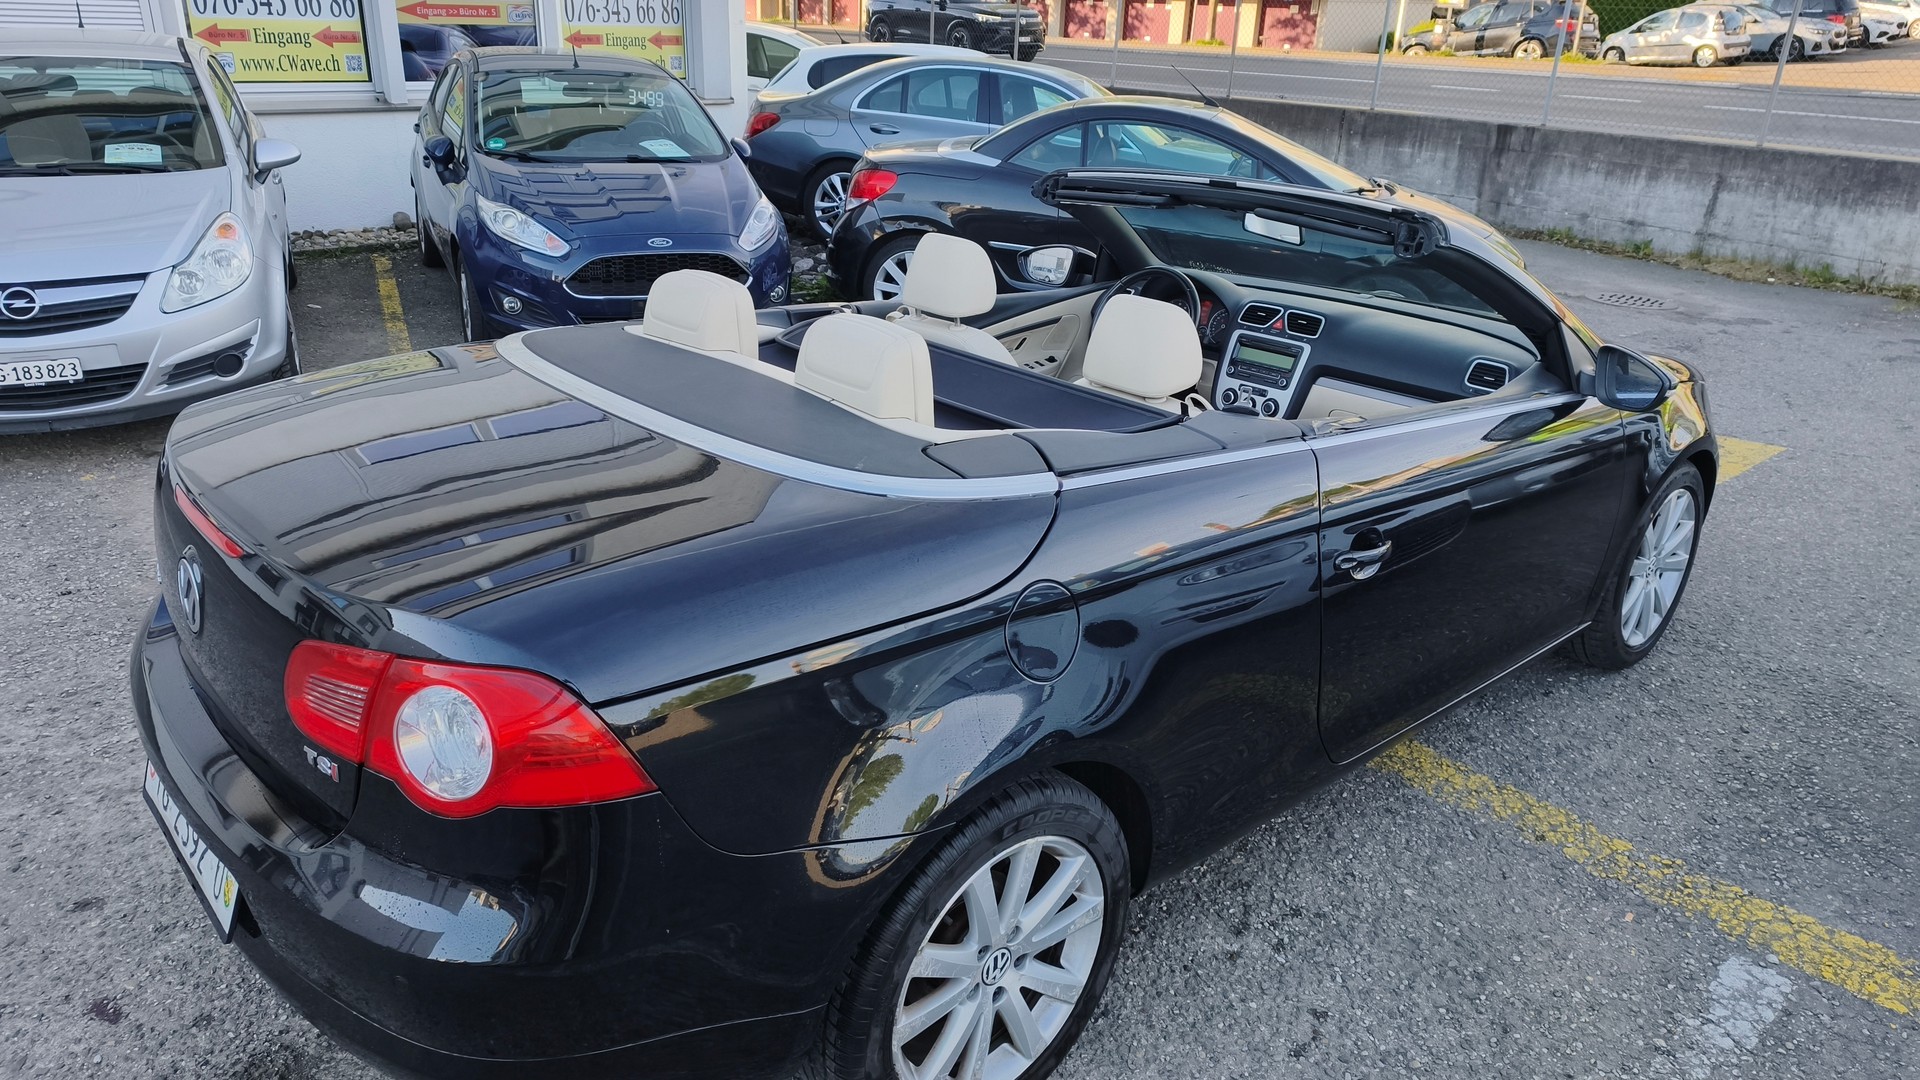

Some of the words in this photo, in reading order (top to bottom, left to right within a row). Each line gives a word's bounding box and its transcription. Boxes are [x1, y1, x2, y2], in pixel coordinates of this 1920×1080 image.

[417, 7, 446, 16] Eingang
[460, 7, 478, 16] Büro
[479, 8, 489, 16] Nr.
[636, 0, 656, 24] 66
[661, 0, 680, 24] 86
[252, 27, 312, 48] Eingang
[605, 33, 647, 50] Eingang
[240, 54, 341, 72] www.CWave.ch
[628, 88, 664, 107] 3499
